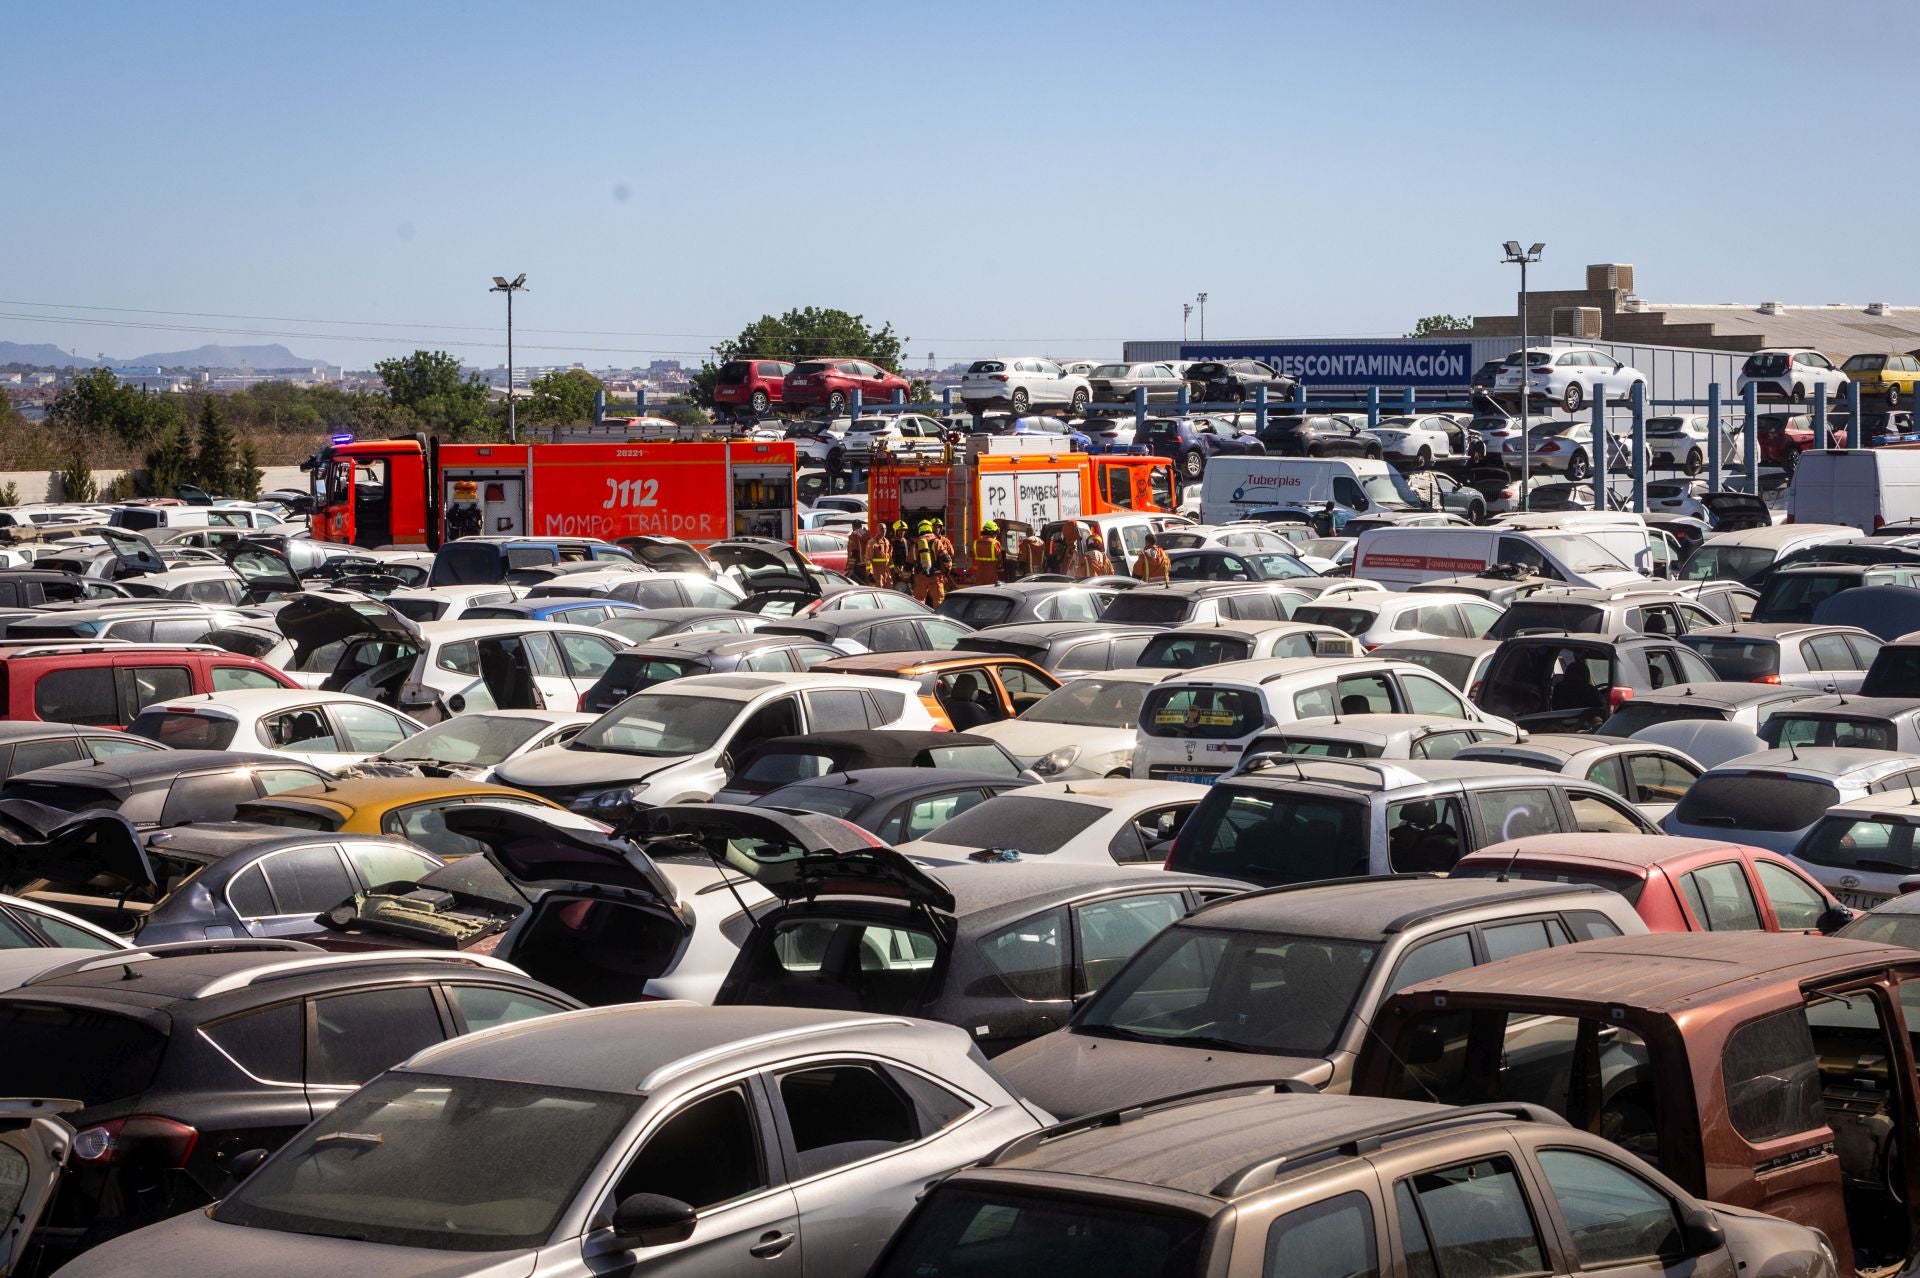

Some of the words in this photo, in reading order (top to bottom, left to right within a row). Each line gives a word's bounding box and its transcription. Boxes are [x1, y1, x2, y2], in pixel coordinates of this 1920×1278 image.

[1271, 350, 1464, 377] DESCONTAMINACIÓN
[616, 449, 644, 457] 28221
[1247, 474, 1301, 488] Tuberplas
[618, 478, 659, 508] 112
[988, 486, 1007, 505] PP
[1019, 485, 1058, 501] BOMBERS
[1031, 503, 1046, 516] EN
[546, 513, 614, 535] MOMPO
